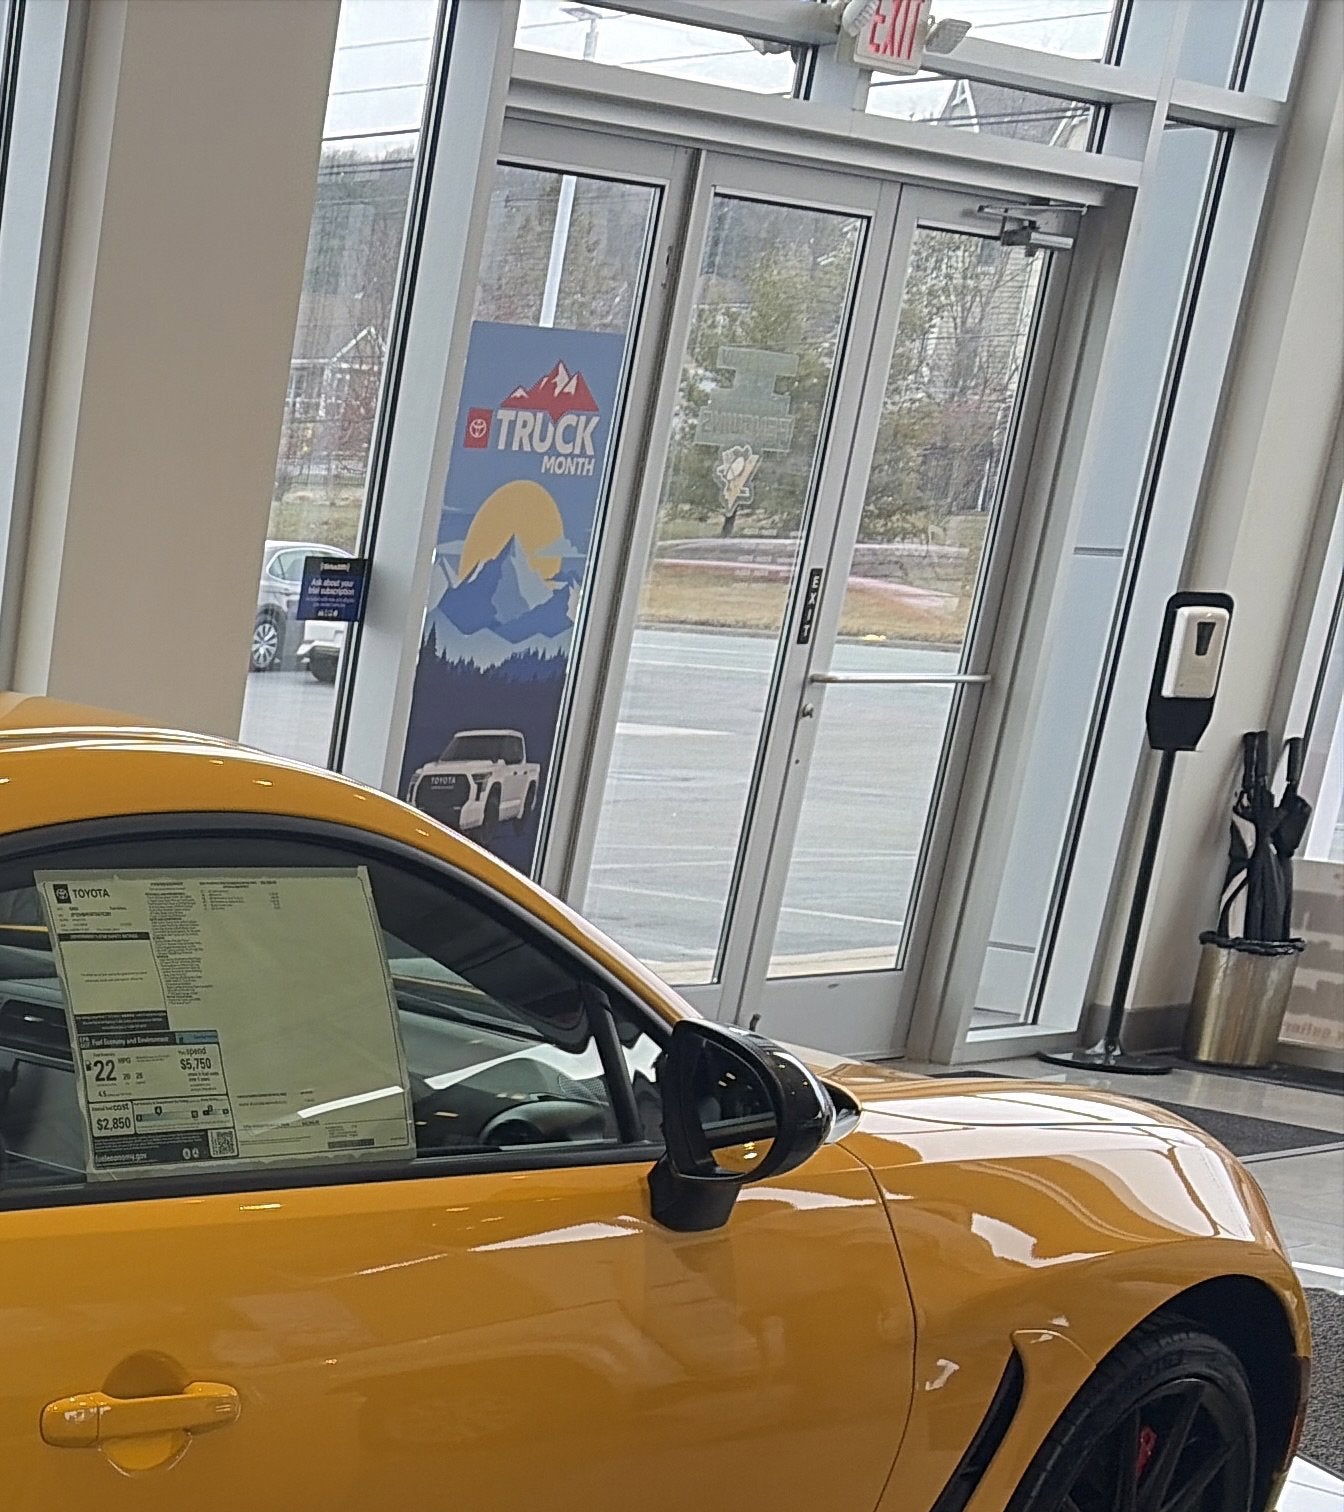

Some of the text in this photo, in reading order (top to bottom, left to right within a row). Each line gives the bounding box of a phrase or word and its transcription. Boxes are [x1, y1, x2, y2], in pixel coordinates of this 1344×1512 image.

[868, 0, 925, 60] EXIT
[496, 409, 600, 456] TRUCK
[541, 455, 595, 476] MONTH
[803, 575, 819, 637] EXIT
[72, 888, 110, 899] TOYOTA
[93, 1060, 117, 1082] 22
[180, 1057, 211, 1071] $5,750
[97, 1117, 131, 1131] $2,850
